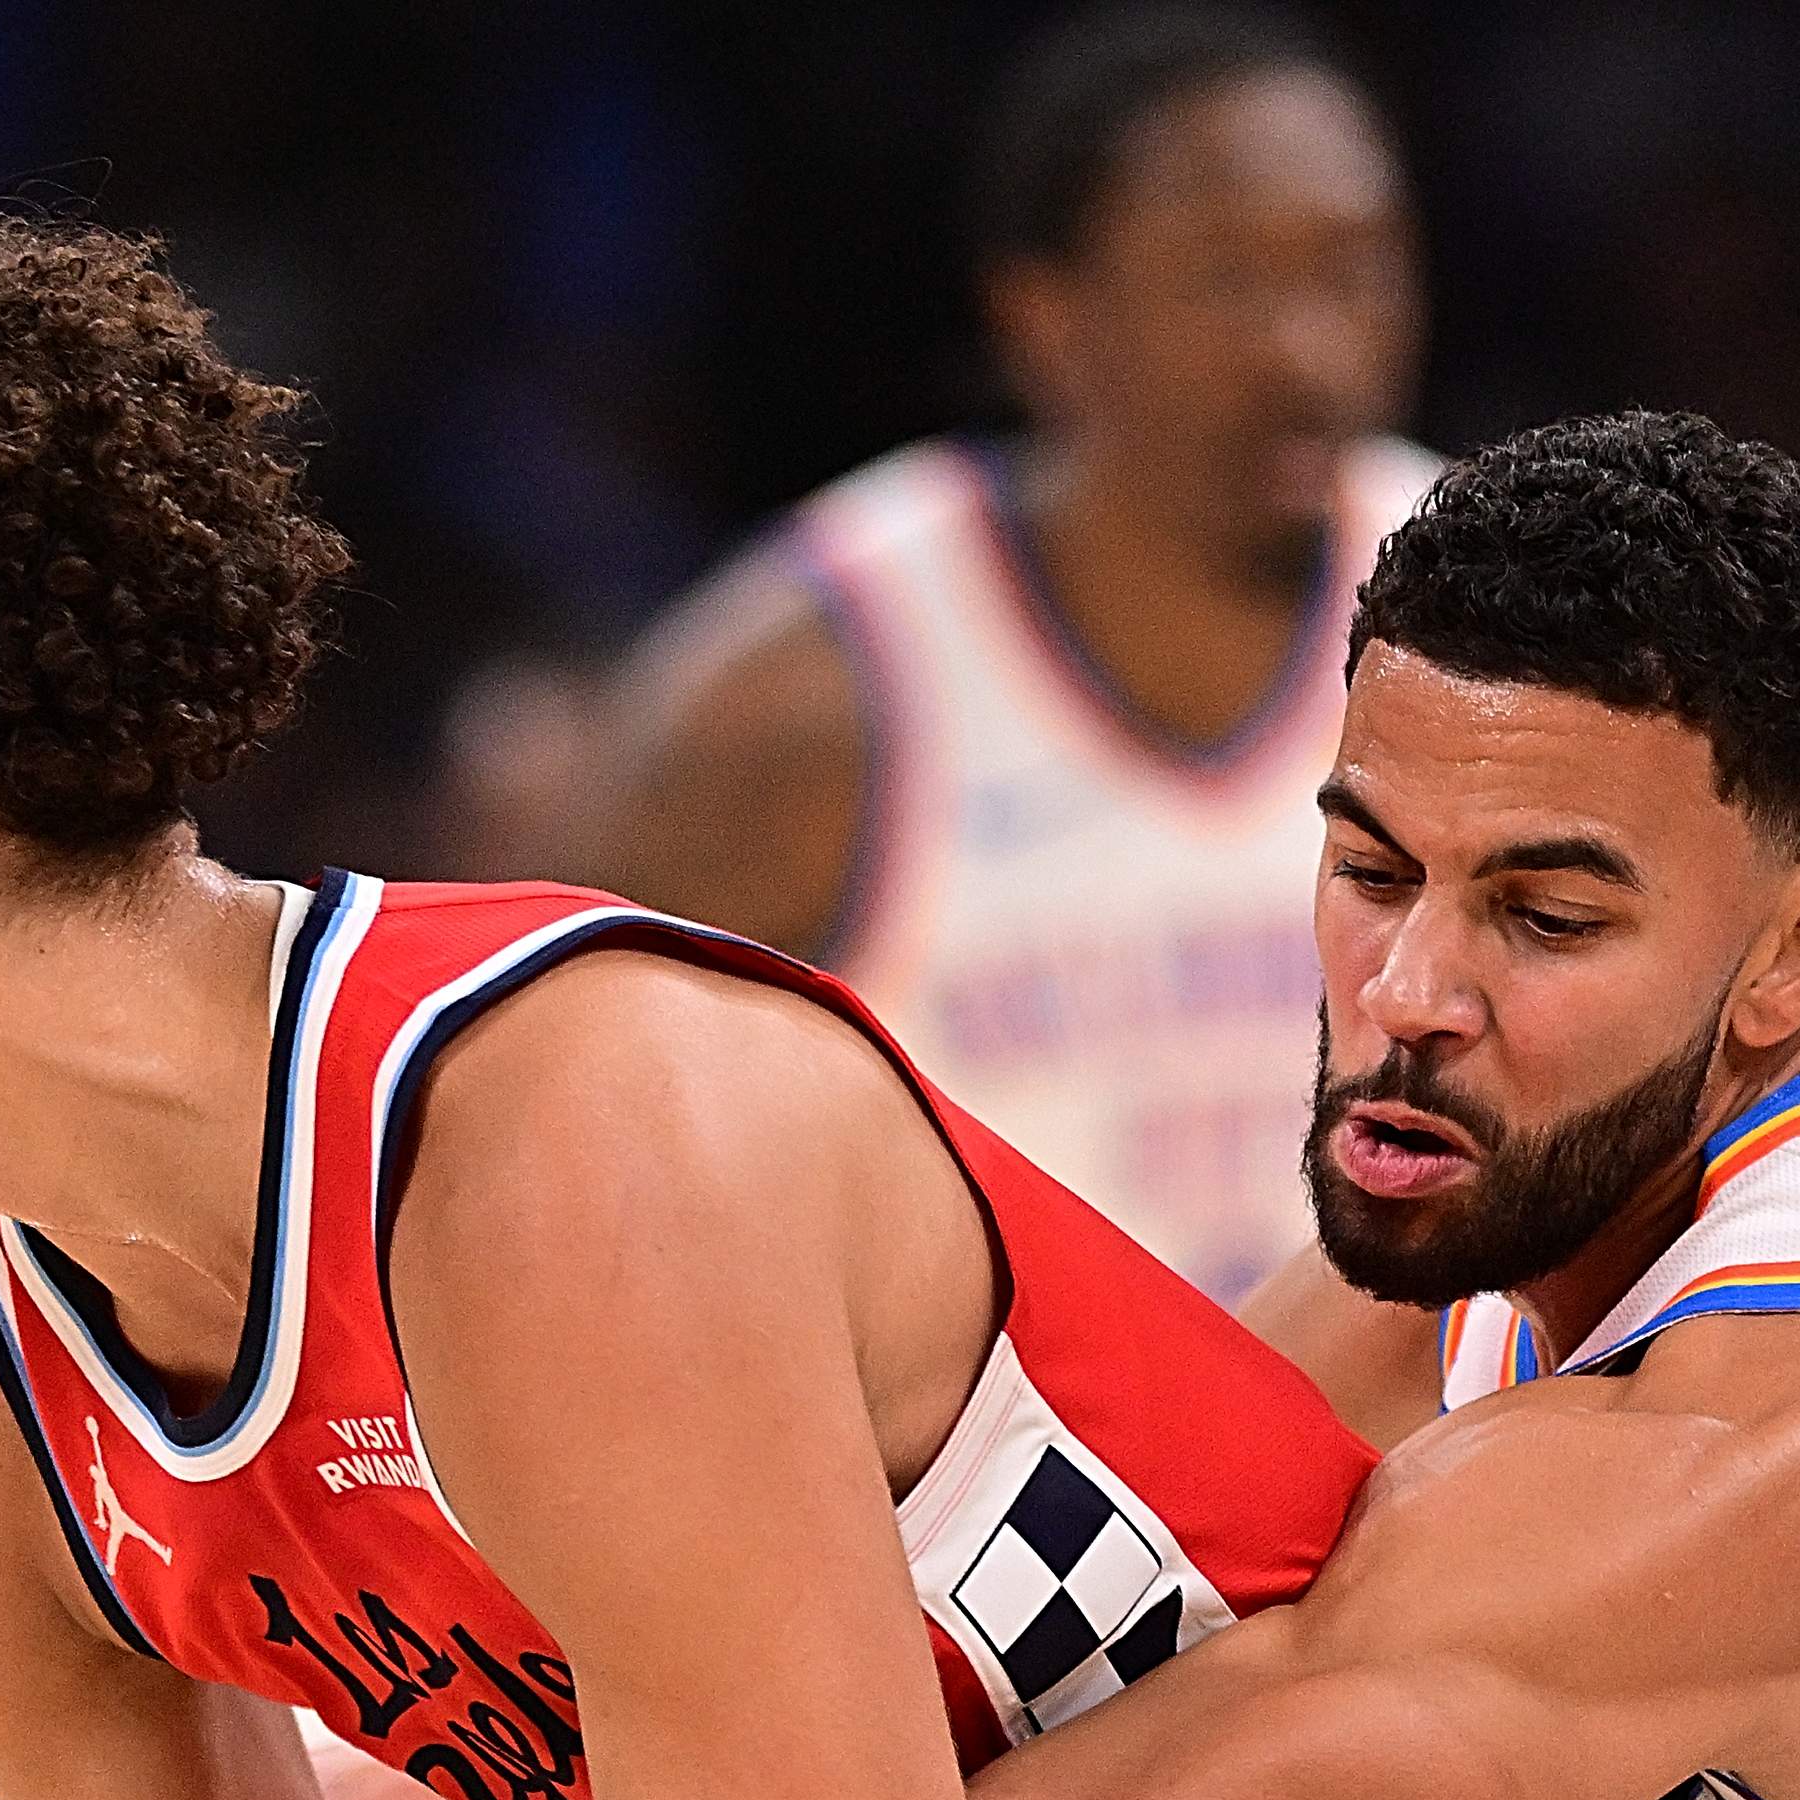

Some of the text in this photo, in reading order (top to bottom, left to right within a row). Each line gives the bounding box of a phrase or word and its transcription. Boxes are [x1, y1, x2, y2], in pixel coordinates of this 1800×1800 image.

[325, 1415, 405, 1450] VISIT
[315, 1453, 423, 1494] RWAND
[247, 1573, 460, 1740] Los
